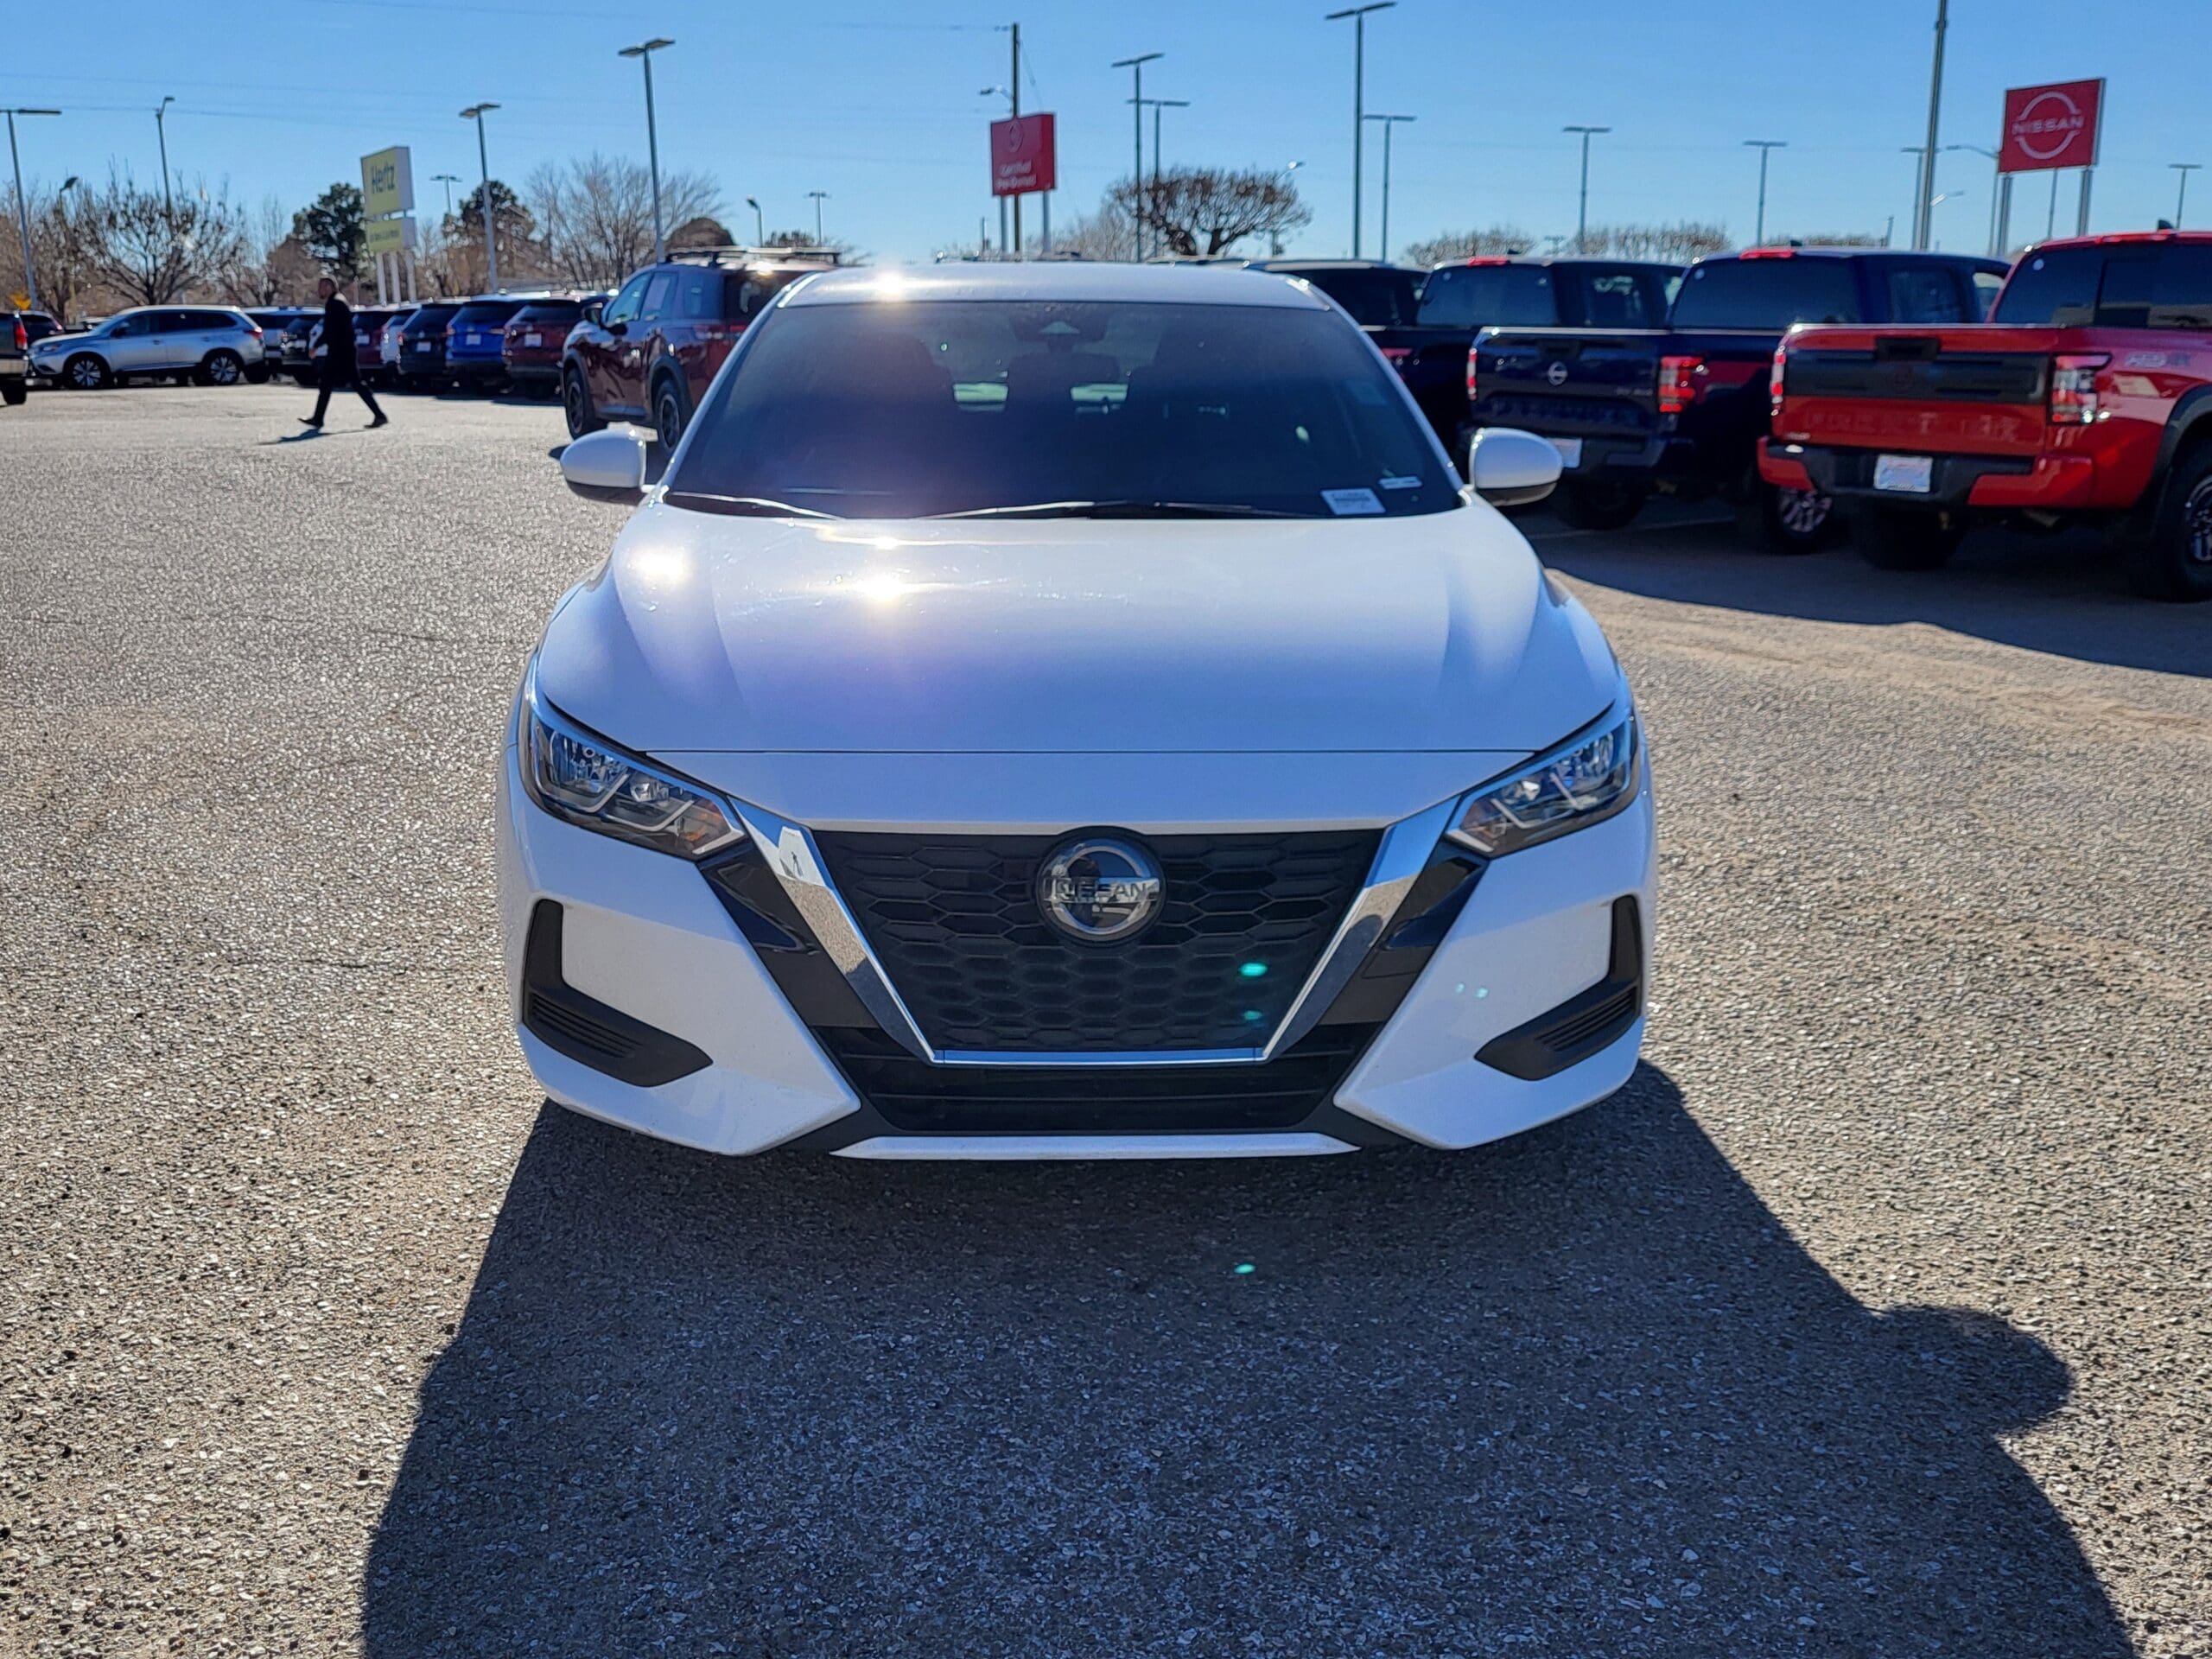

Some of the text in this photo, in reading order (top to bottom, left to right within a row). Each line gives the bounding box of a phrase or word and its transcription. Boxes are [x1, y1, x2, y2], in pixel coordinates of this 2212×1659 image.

[2012, 116, 2083, 135] NISSAN
[371, 162, 395, 194] Hertz
[1054, 881, 1147, 899] NISSAN
